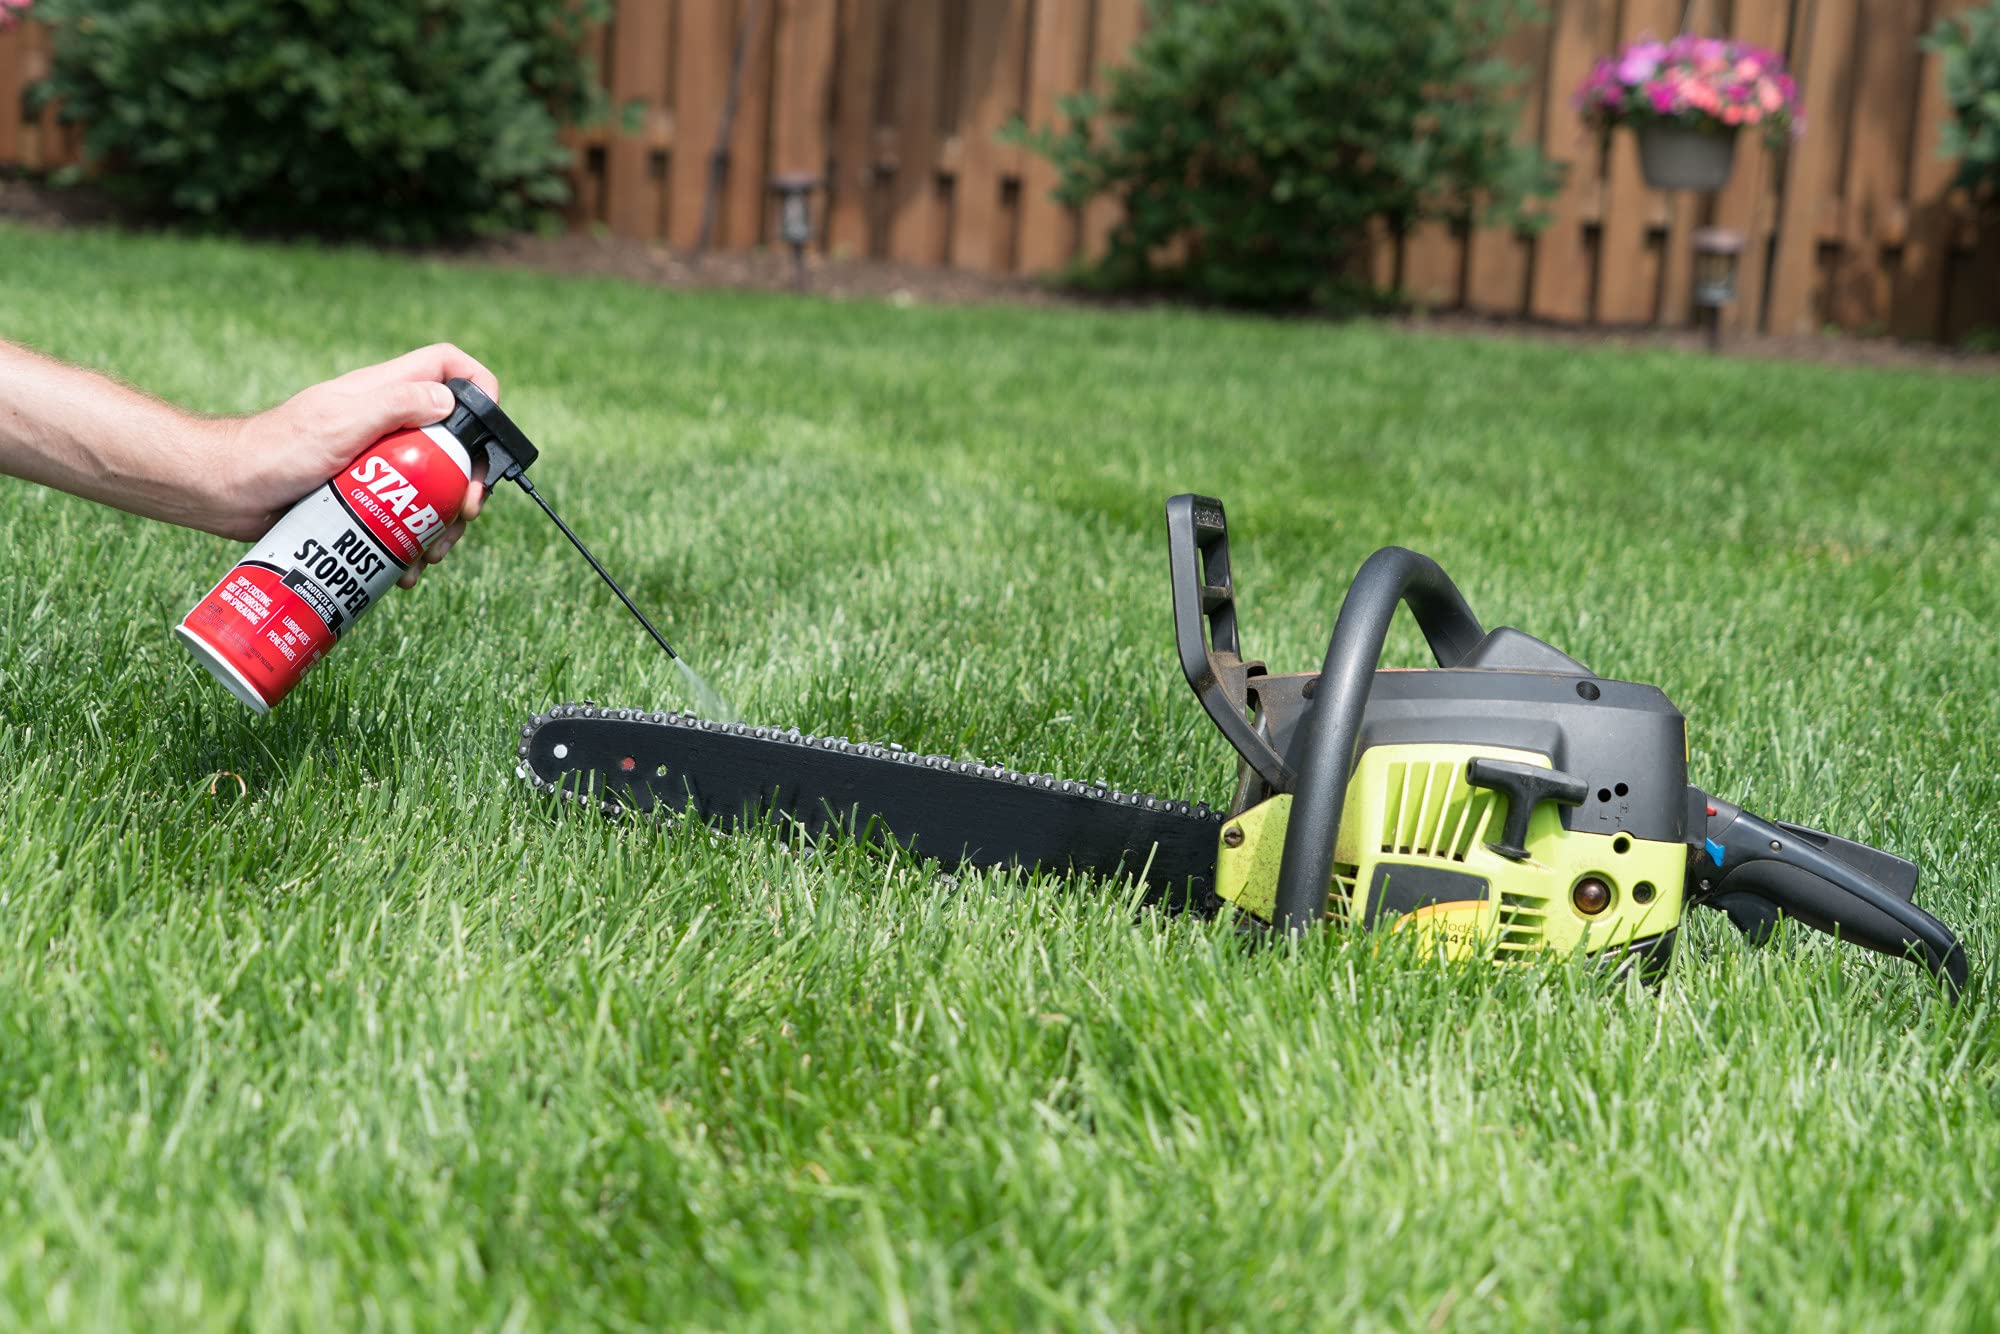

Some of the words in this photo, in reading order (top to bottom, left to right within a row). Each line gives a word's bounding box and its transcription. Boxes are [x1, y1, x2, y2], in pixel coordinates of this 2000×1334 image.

[350, 488, 395, 529] CORROSION
[331, 528, 386, 583] RUST
[293, 538, 370, 618] STOPPER
[230, 597, 260, 624] SPREADING
[238, 591, 269, 618] CORROSION
[247, 584, 272, 607] EXISTING
[293, 583, 318, 607] COMMON
[314, 603, 332, 623] METALS
[302, 579, 329, 606] PROTECTS
[326, 604, 336, 614] ALL
[266, 630, 296, 661] PENETRATES
[281, 615, 310, 645] LUBRICATES
[282, 632, 296, 645] AND
